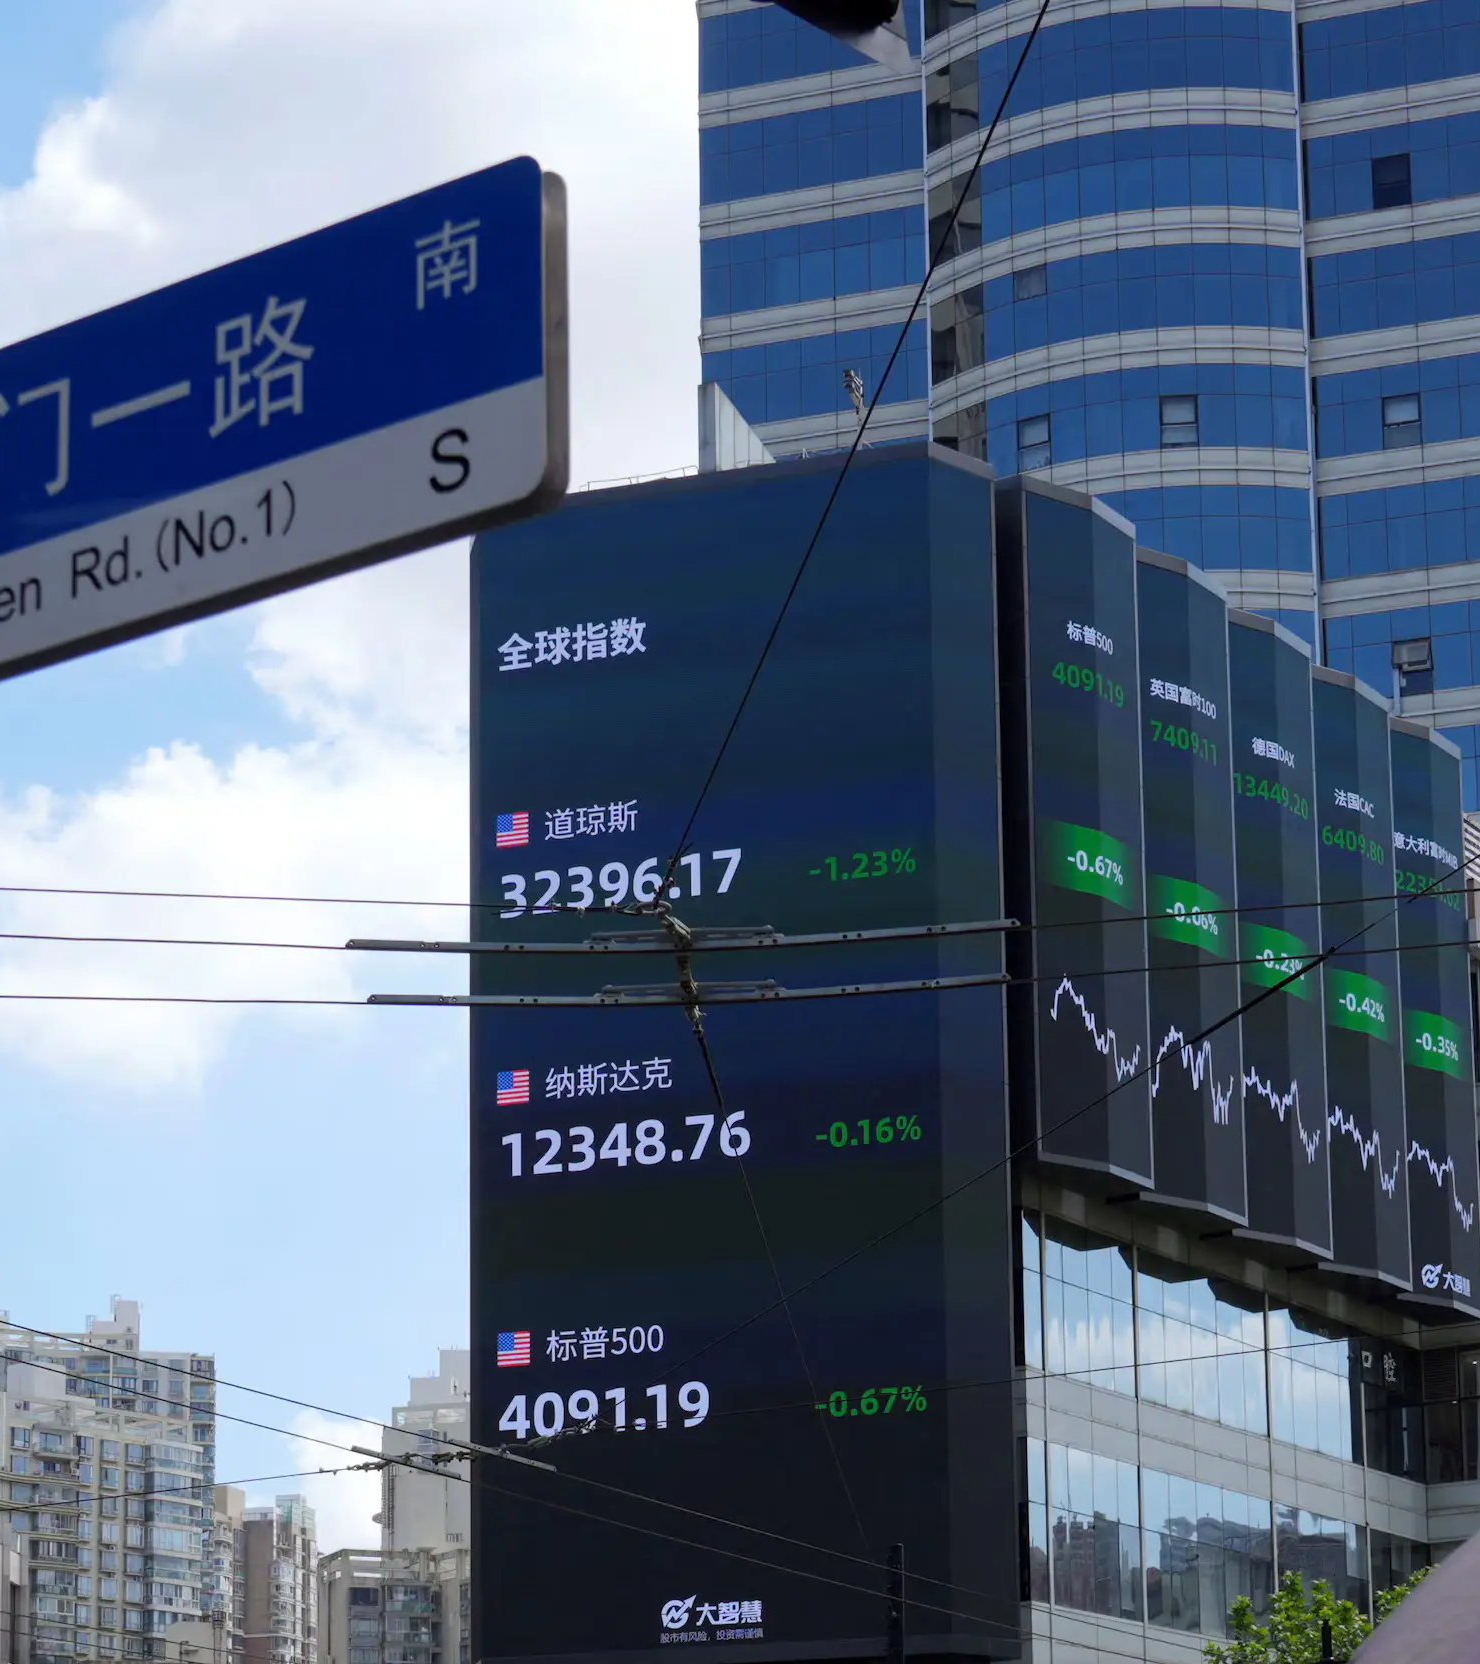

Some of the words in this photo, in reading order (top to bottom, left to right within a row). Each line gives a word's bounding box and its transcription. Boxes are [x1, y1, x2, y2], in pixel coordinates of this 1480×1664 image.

[415, 219, 482, 310] 南
[428, 428, 471, 495] S
[497, 616, 647, 672] 全球指数
[1066, 620, 1114, 656] 标普500
[1052, 661, 1125, 708] 4091.19
[1149, 678, 1217, 719] 英国富时100
[1149, 720, 1218, 766] 7409.11
[1251, 736, 1295, 768] 德国DAX
[1233, 772, 1309, 820] 13449.20
[1333, 788, 1375, 819] 法国CAC
[544, 799, 639, 842] 道琼斯
[1321, 824, 1386, 867] 6409.80
[1393, 831, 1459, 870] 意大利富时MIB
[499, 847, 743, 919] 32396.17
[808, 847, 917, 884] -1.23%
[1067, 849, 1124, 886] -0.67%
[1166, 902, 1218, 935] -0.06%
[1255, 948, 1305, 980] -0.23%
[1338, 993, 1386, 1024] -0.42%
[1415, 1032, 1459, 1062] -0.35%
[544, 1057, 673, 1100] 纳斯达克
[502, 1110, 752, 1178] 12348.76
[816, 1114, 921, 1147] -0.16%
[546, 1325, 664, 1363] 标普500
[498, 1381, 710, 1440] 4091.19
[815, 1385, 927, 1418] -0.67%
[695, 1600, 763, 1627] 大智慧
